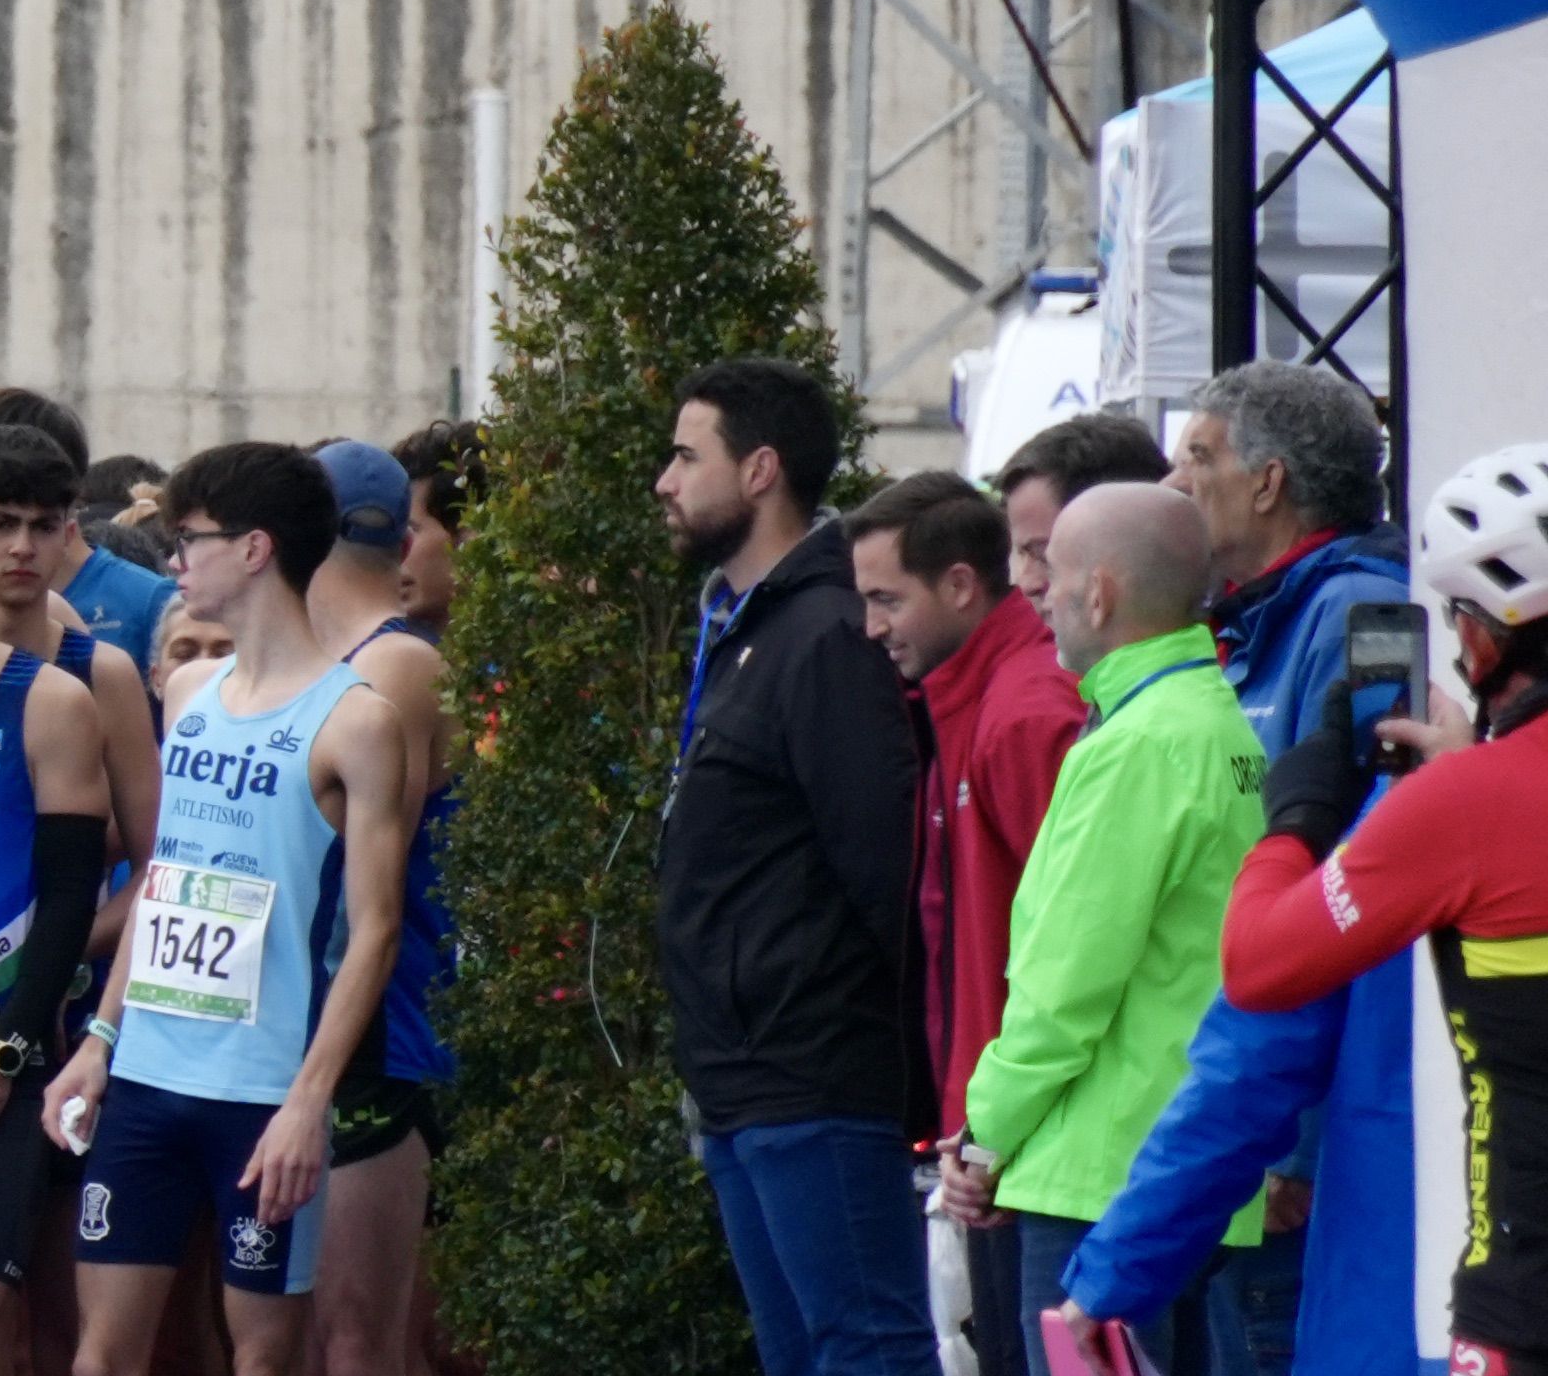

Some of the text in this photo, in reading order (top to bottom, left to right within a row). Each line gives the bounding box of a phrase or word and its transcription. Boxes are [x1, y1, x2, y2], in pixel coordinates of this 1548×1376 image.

[165, 744, 280, 801] nerja
[172, 796, 254, 830] ATLETISMO
[150, 914, 237, 981] 1542
